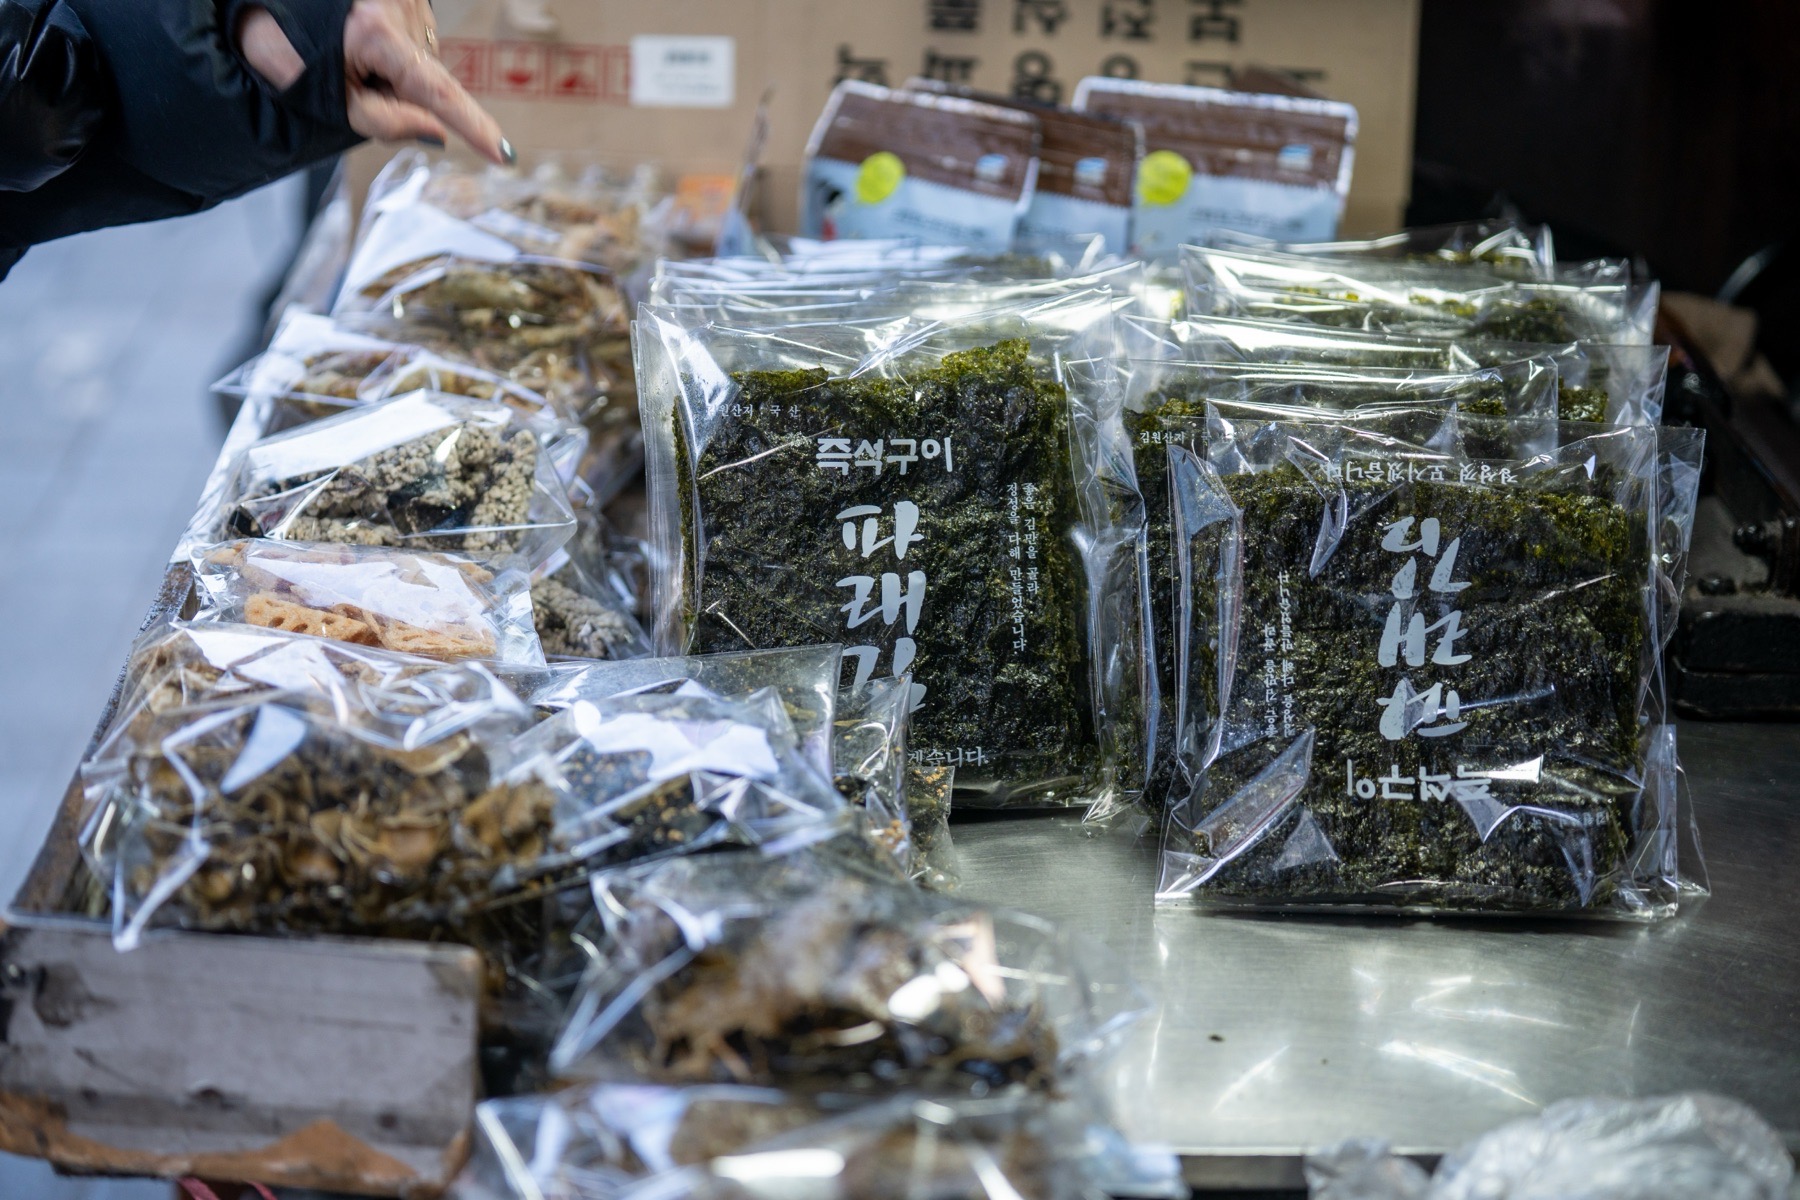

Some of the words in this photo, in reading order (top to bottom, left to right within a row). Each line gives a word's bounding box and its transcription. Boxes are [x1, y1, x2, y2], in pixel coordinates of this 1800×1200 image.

[815, 437, 954, 476] 즉석구이
[1459, 462, 1519, 485] 정성껏
[1006, 482, 1020, 525] 정성을
[1022, 482, 1039, 510] 좋은
[1008, 532, 1022, 560] 다해
[1024, 517, 1039, 560] 김만을
[1026, 567, 1040, 595] 골라
[1376, 516, 1473, 741] 파래김
[1263, 659, 1278, 703] 김만을
[1281, 658, 1296, 687] 다해
[1346, 759, 1492, 801] 즉석구이
